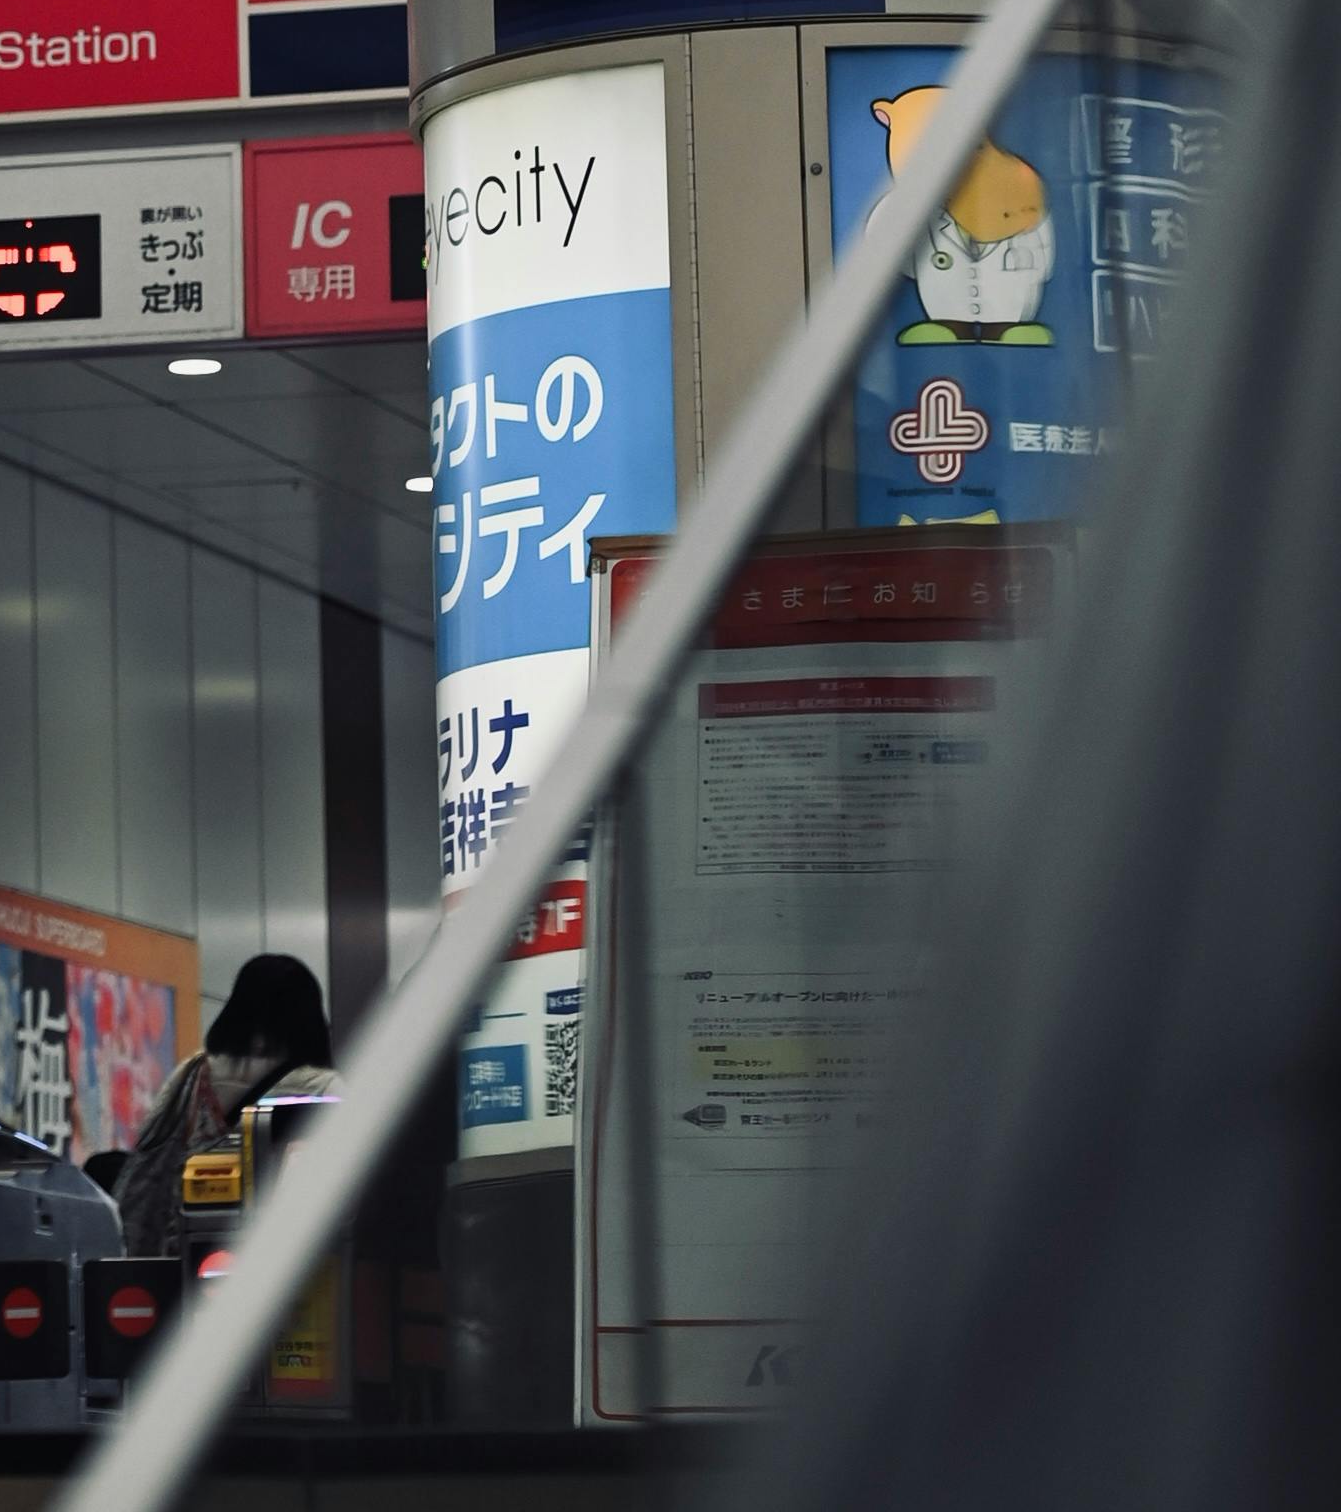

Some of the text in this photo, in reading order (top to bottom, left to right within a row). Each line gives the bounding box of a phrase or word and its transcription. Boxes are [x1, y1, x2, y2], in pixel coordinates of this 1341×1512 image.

[291, 200, 353, 250] IC
[141, 230, 204, 263] きっぷ
[141, 281, 204, 315] 定期
[287, 264, 355, 303] 専用
[639, 580, 1025, 611] さまにお知らせ
